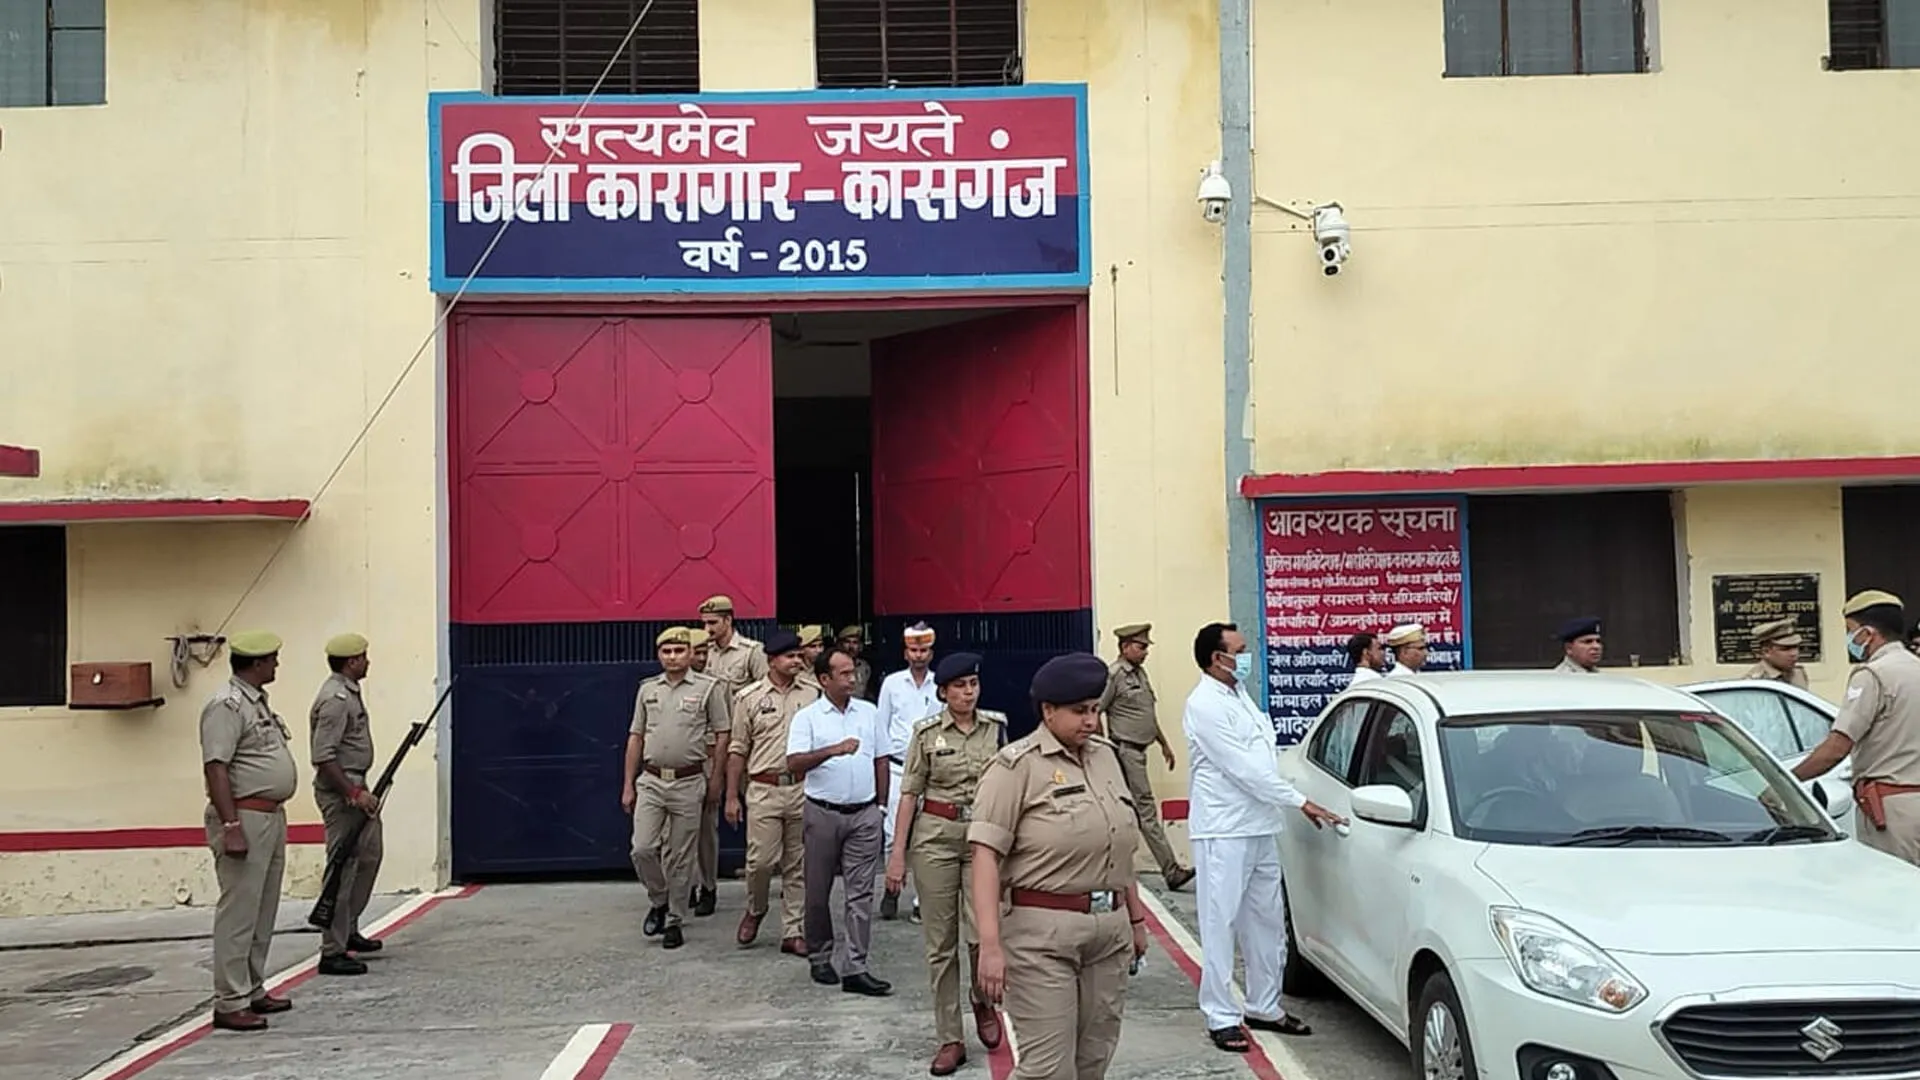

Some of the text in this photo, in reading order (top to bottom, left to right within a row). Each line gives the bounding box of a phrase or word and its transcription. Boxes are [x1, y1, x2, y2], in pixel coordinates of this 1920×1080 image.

[539, 102, 964, 160] सत्यमेव जयते
[451, 132, 579, 223] जिला
[586, 161, 801, 223] कारागार
[841, 128, 1067, 221] कासगंज
[678, 226, 744, 273] वर्ष
[778, 239, 868, 272] 2015
[1265, 507, 1457, 539] आवश्यक सूचना
